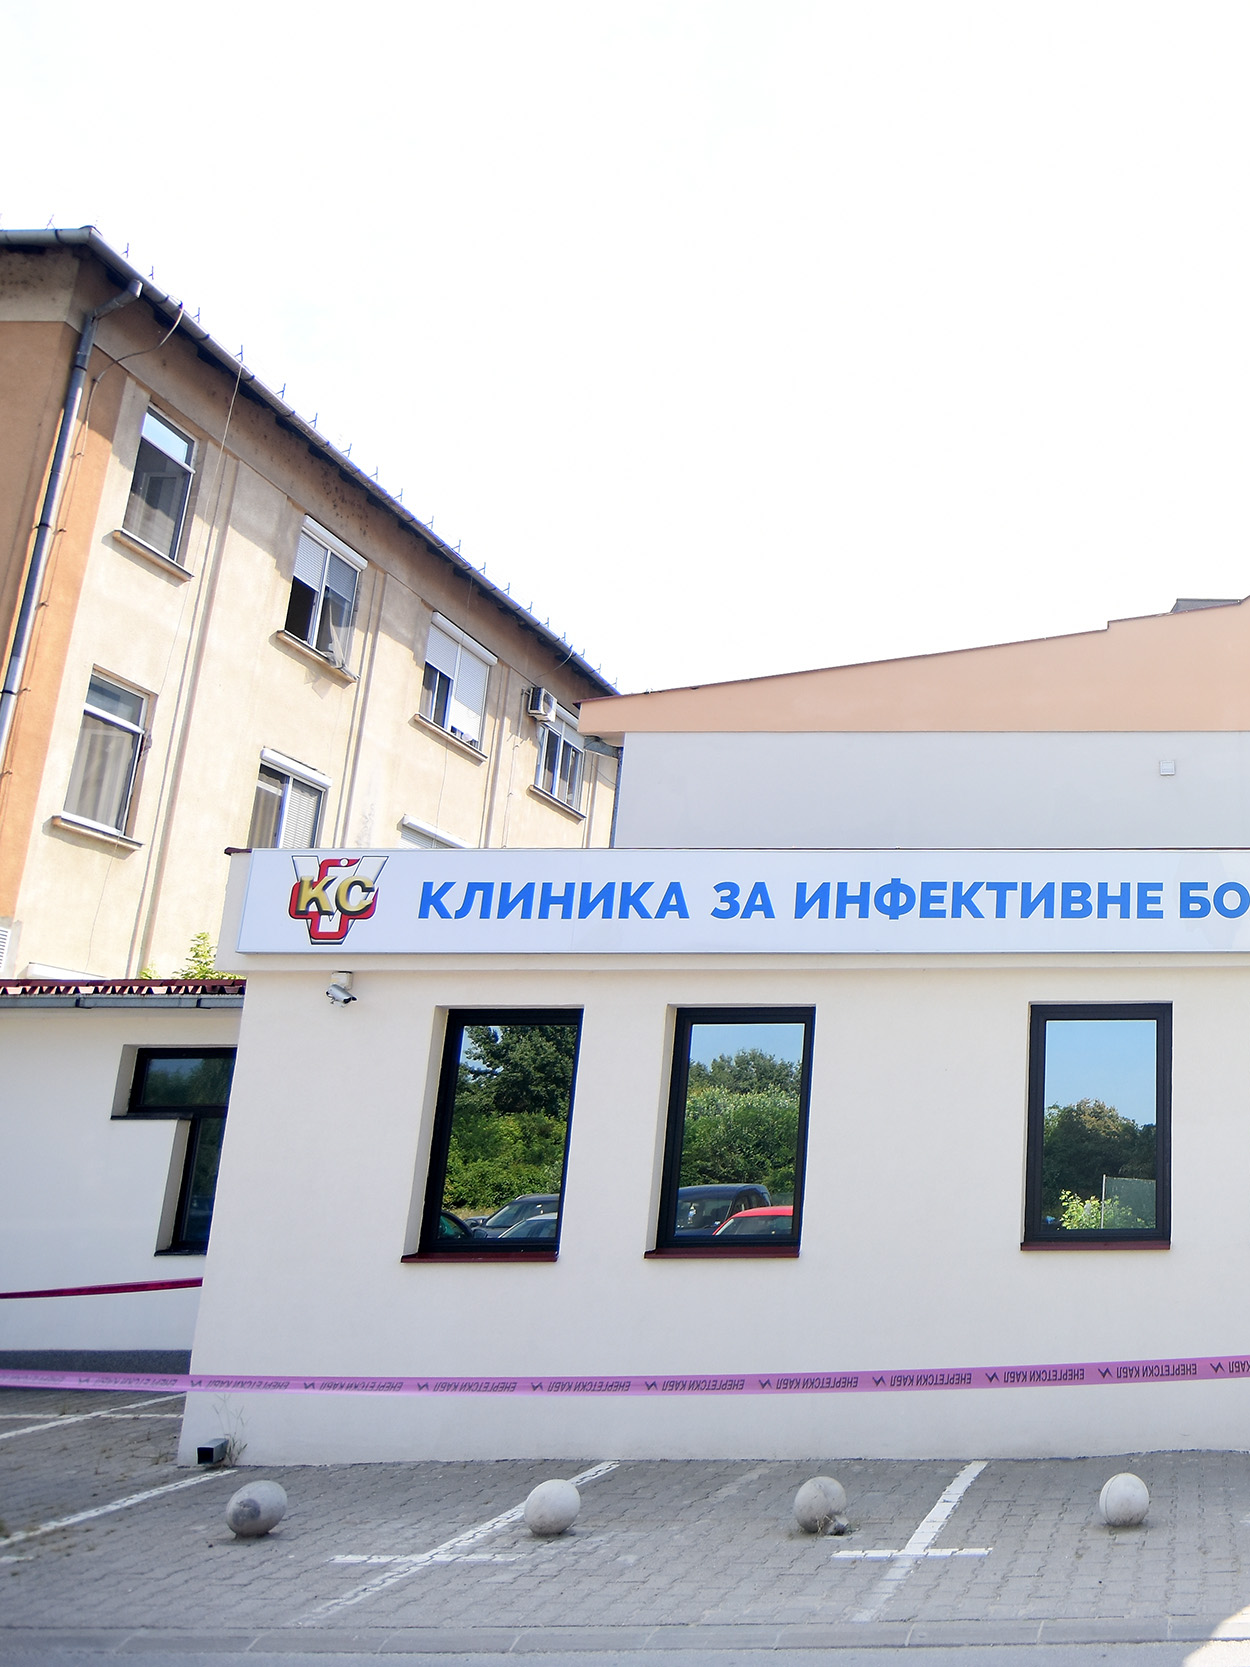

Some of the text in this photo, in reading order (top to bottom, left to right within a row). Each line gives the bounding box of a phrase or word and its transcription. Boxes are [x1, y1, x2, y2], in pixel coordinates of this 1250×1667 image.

[418, 881, 690, 920] КЛИНИКА
[711, 881, 776, 920] ЗА
[794, 877, 1164, 920] ИНФЕКТИВНЕ
[1003, 1368, 1085, 1383] ЕНЕРГЕТСКИ КАБЛ
[1116, 1363, 1197, 1379] ЕНЕРГЕТСКИ КАБЛ
[547, 1380, 632, 1393] ЕНЕРГЕТСКИ КАБЛ
[662, 1379, 745, 1391] ЕНЕРГЕТСКИ КАБЛ
[776, 1376, 859, 1390] ЕНЕРГЕТСКИ КАБЛ
[890, 1372, 972, 1387] ЕНЕРГЕТСКИ КАБЛ
[459, 1381, 518, 1393] ЕНЕРГЕТСКИ
